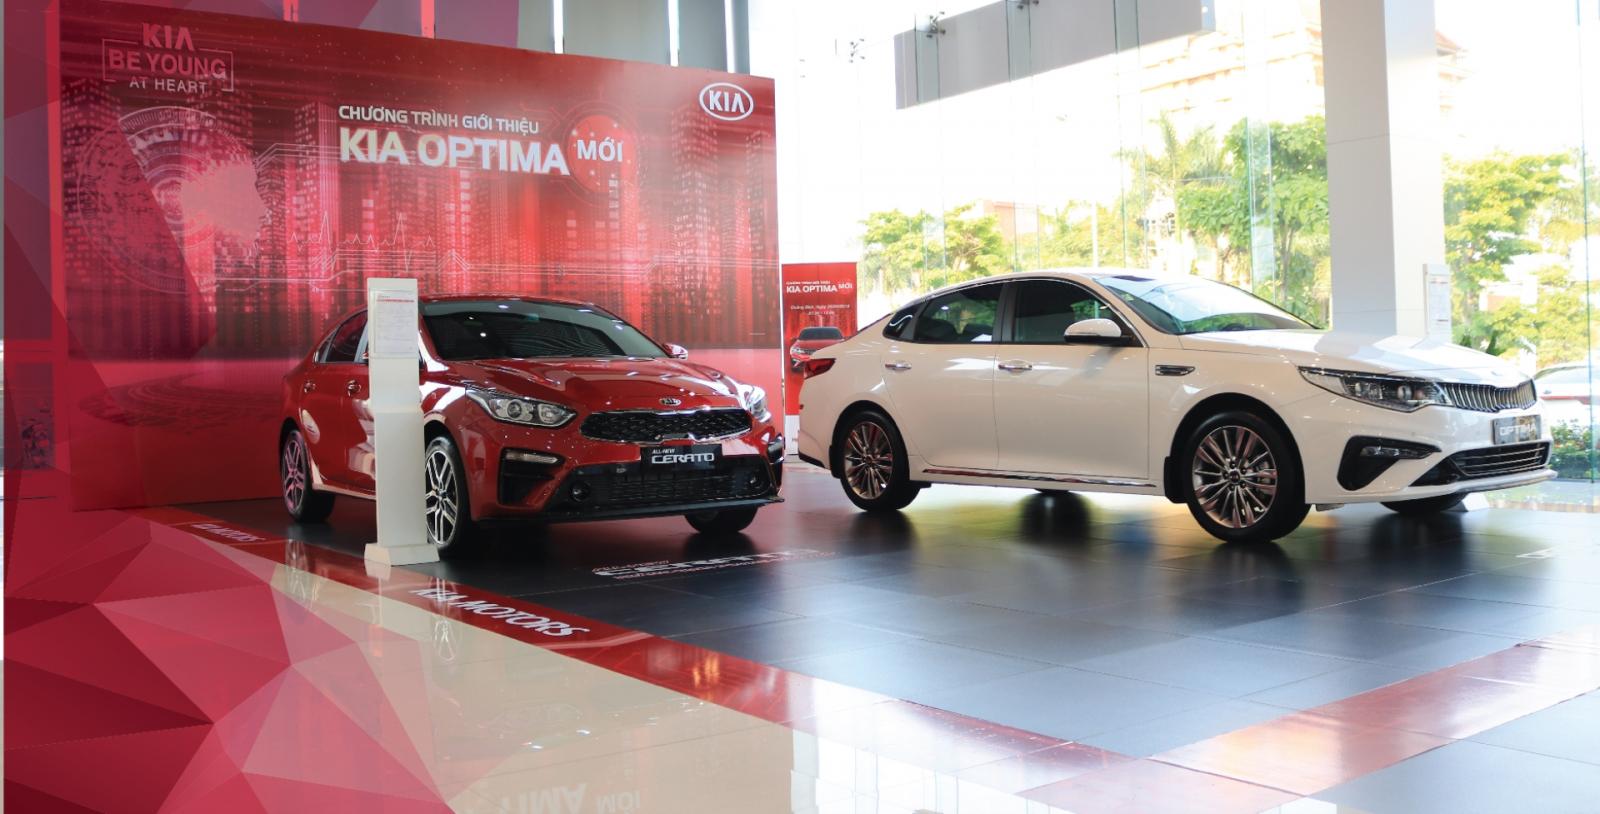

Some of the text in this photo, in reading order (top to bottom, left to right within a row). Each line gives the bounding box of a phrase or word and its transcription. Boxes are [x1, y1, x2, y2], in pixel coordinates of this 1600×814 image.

[142, 22, 195, 51] KIA
[108, 48, 227, 80] BE YOUNG
[129, 75, 207, 95] AT HEART
[709, 90, 745, 113] KIA
[338, 105, 539, 136] CHƯƠNG TRÌNH GIỚI THIỆU
[340, 127, 624, 176] KIA OPTIMA MỚI
[802, 285, 838, 293] OPTIMA
[651, 452, 715, 464] CERATO
[448, 600, 591, 636] MOTORS
